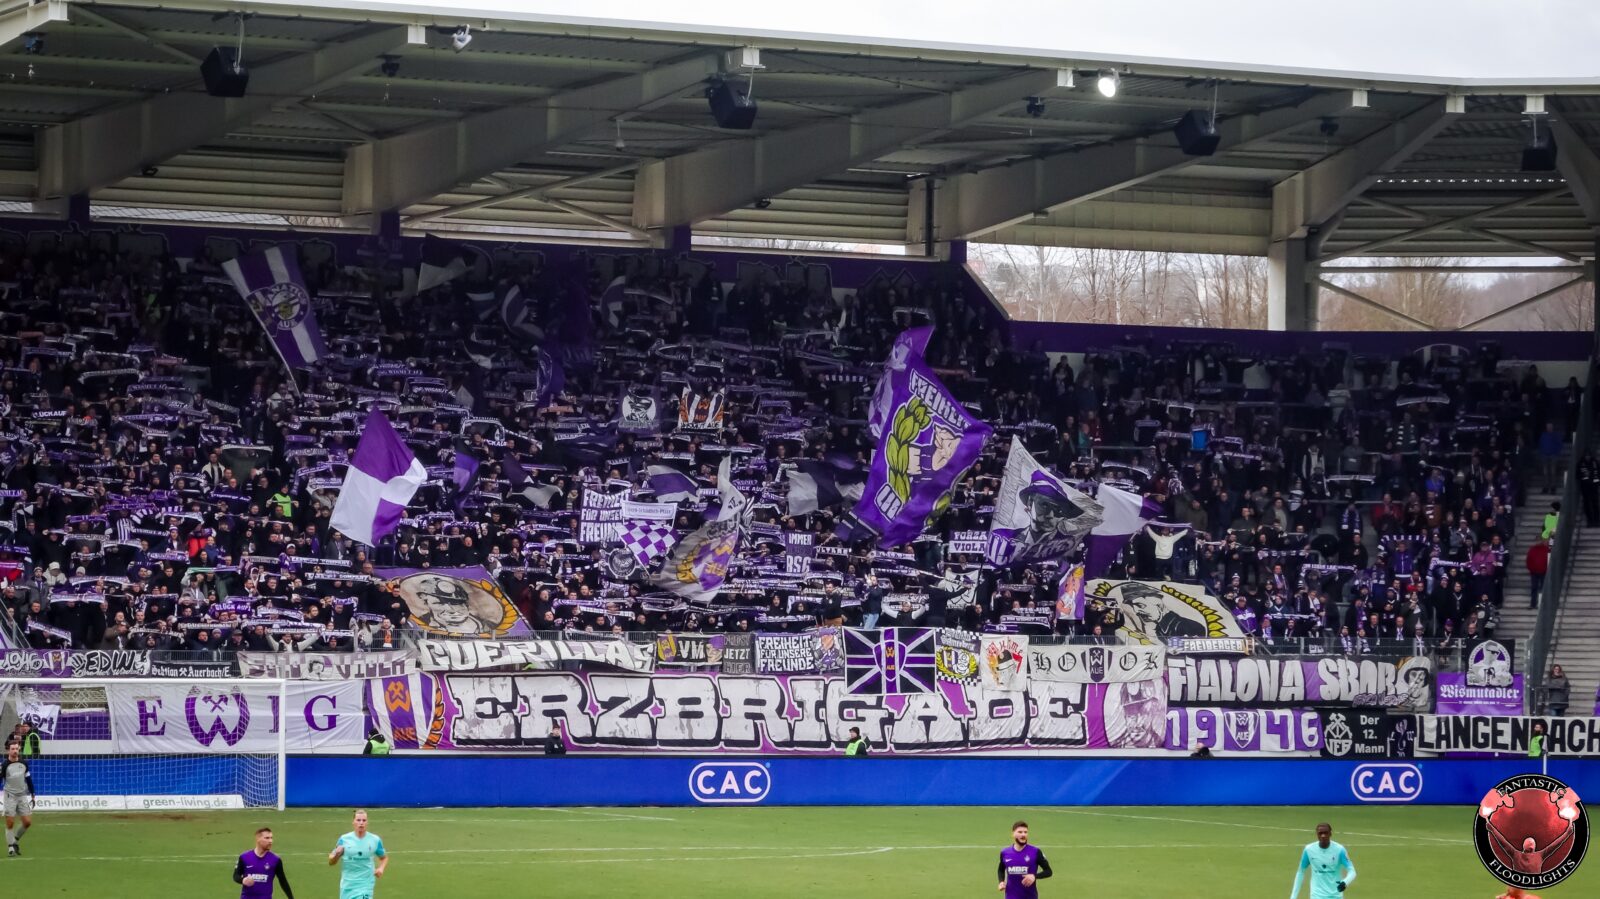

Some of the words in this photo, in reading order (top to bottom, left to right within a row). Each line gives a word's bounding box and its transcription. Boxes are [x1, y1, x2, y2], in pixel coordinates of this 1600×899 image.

[788, 533, 812, 546] IMMER
[758, 635, 813, 650] FREIHEIT
[1183, 640, 1243, 652] FREIBERGER
[419, 640, 656, 673] GUERILLAS
[678, 641, 705, 660] VM
[724, 648, 751, 660] JETZT
[779, 650, 813, 659] UNSERE
[760, 659, 815, 672] FREUNDE
[1167, 657, 1305, 702] FIALOVA
[1440, 684, 1520, 699] Wismutadler
[446, 673, 1088, 746] ERZBRIGADE
[1360, 714, 1380, 726] Der
[1363, 729, 1378, 740] 12.
[1354, 743, 1385, 754] Mann
[696, 769, 763, 795] CAC
[1357, 770, 1416, 794] CAC
[142, 797, 228, 809] green-living.de
